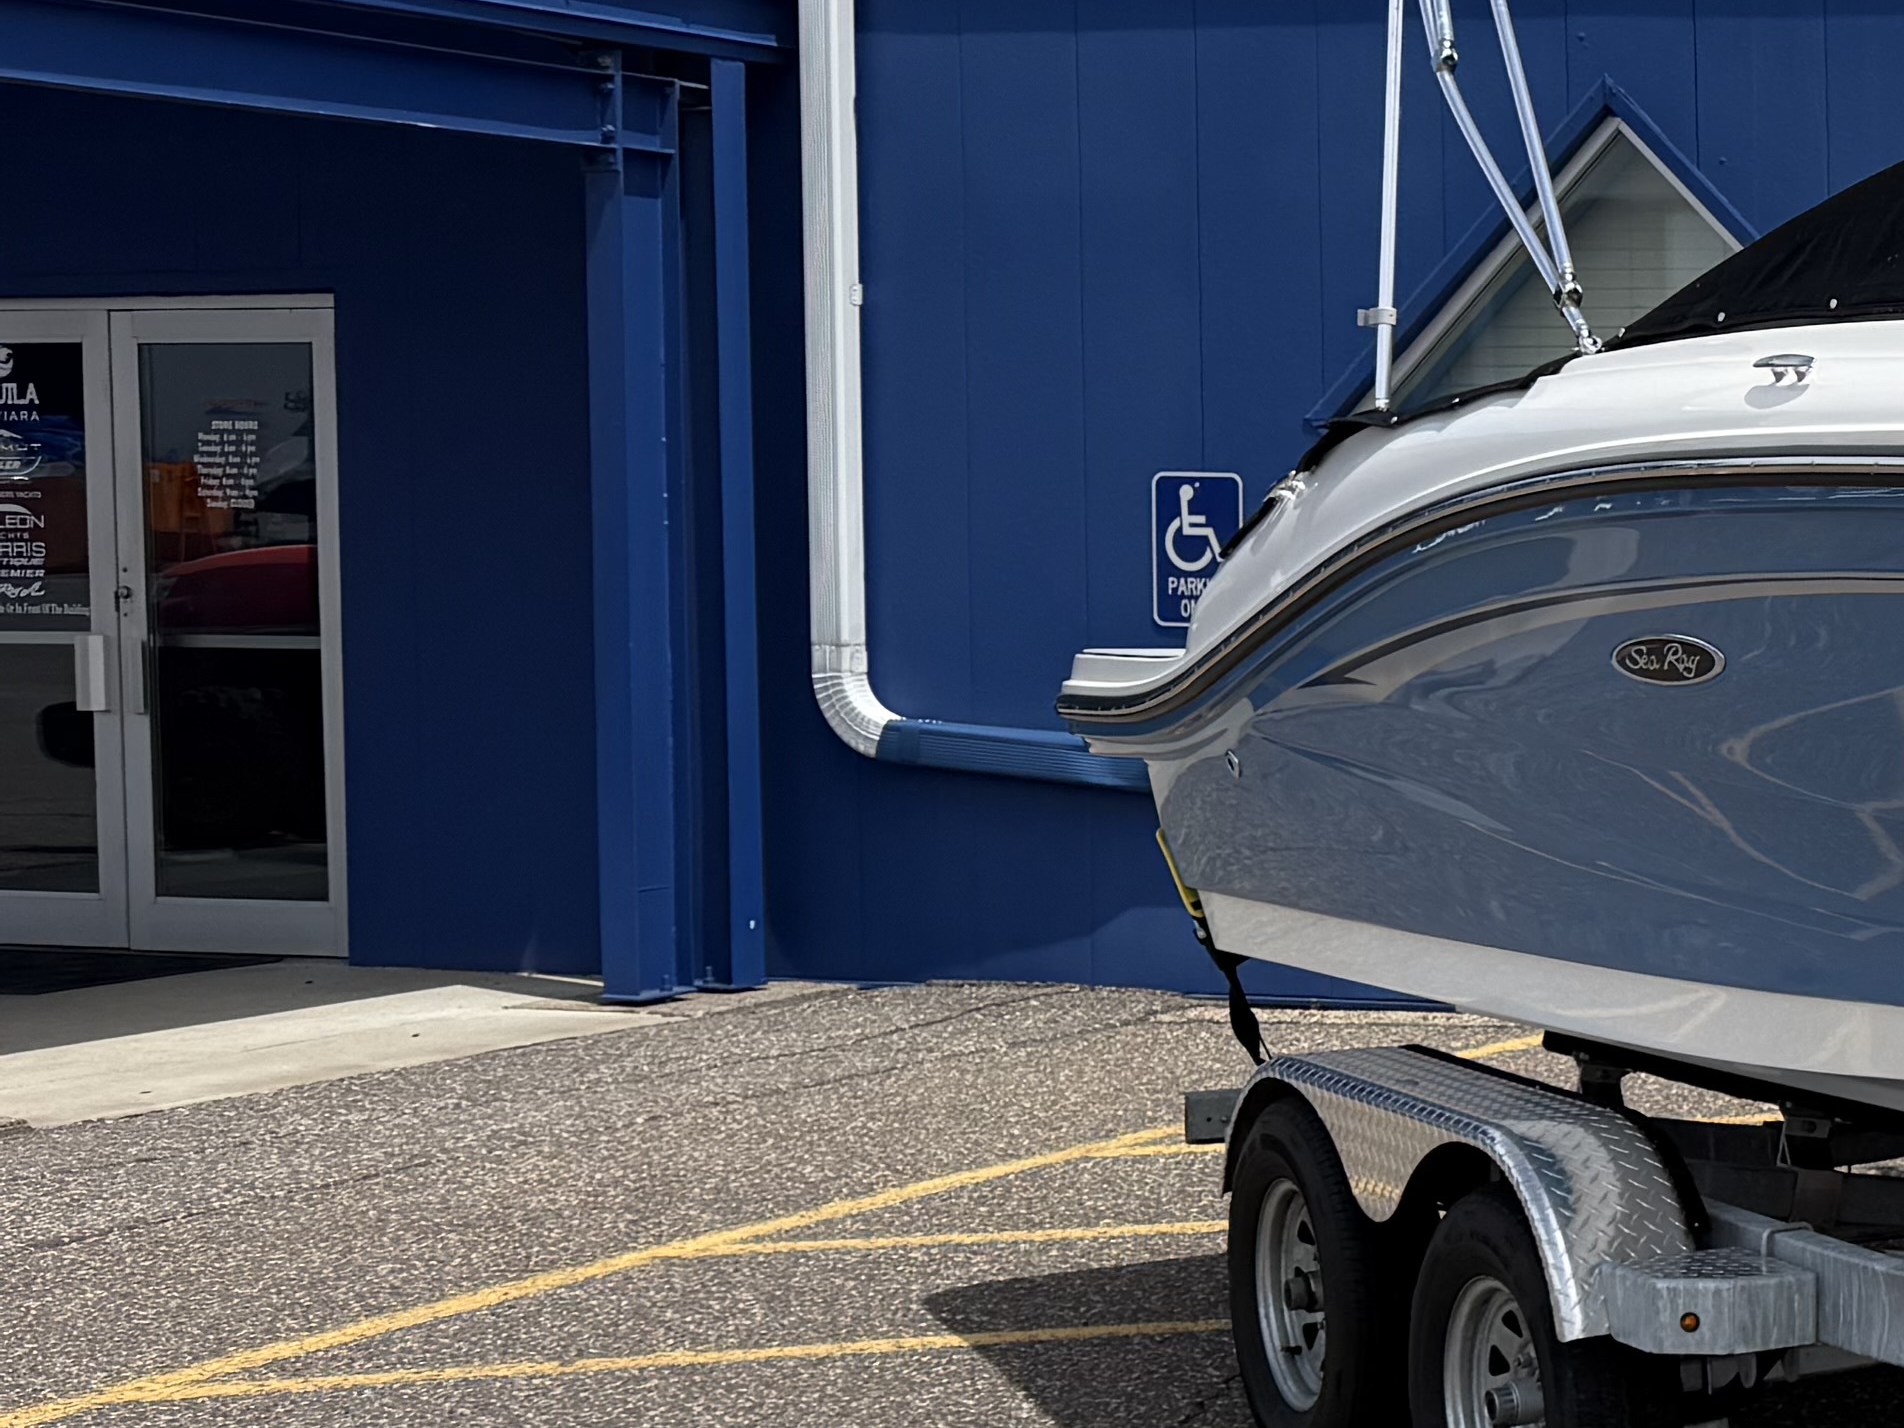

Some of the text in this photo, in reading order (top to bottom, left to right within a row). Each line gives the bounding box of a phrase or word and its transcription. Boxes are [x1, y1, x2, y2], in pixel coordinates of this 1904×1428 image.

[0, 411, 40, 421] IARA
[1168, 576, 1210, 596] PARK
[1625, 643, 1700, 677] Sea Ray
